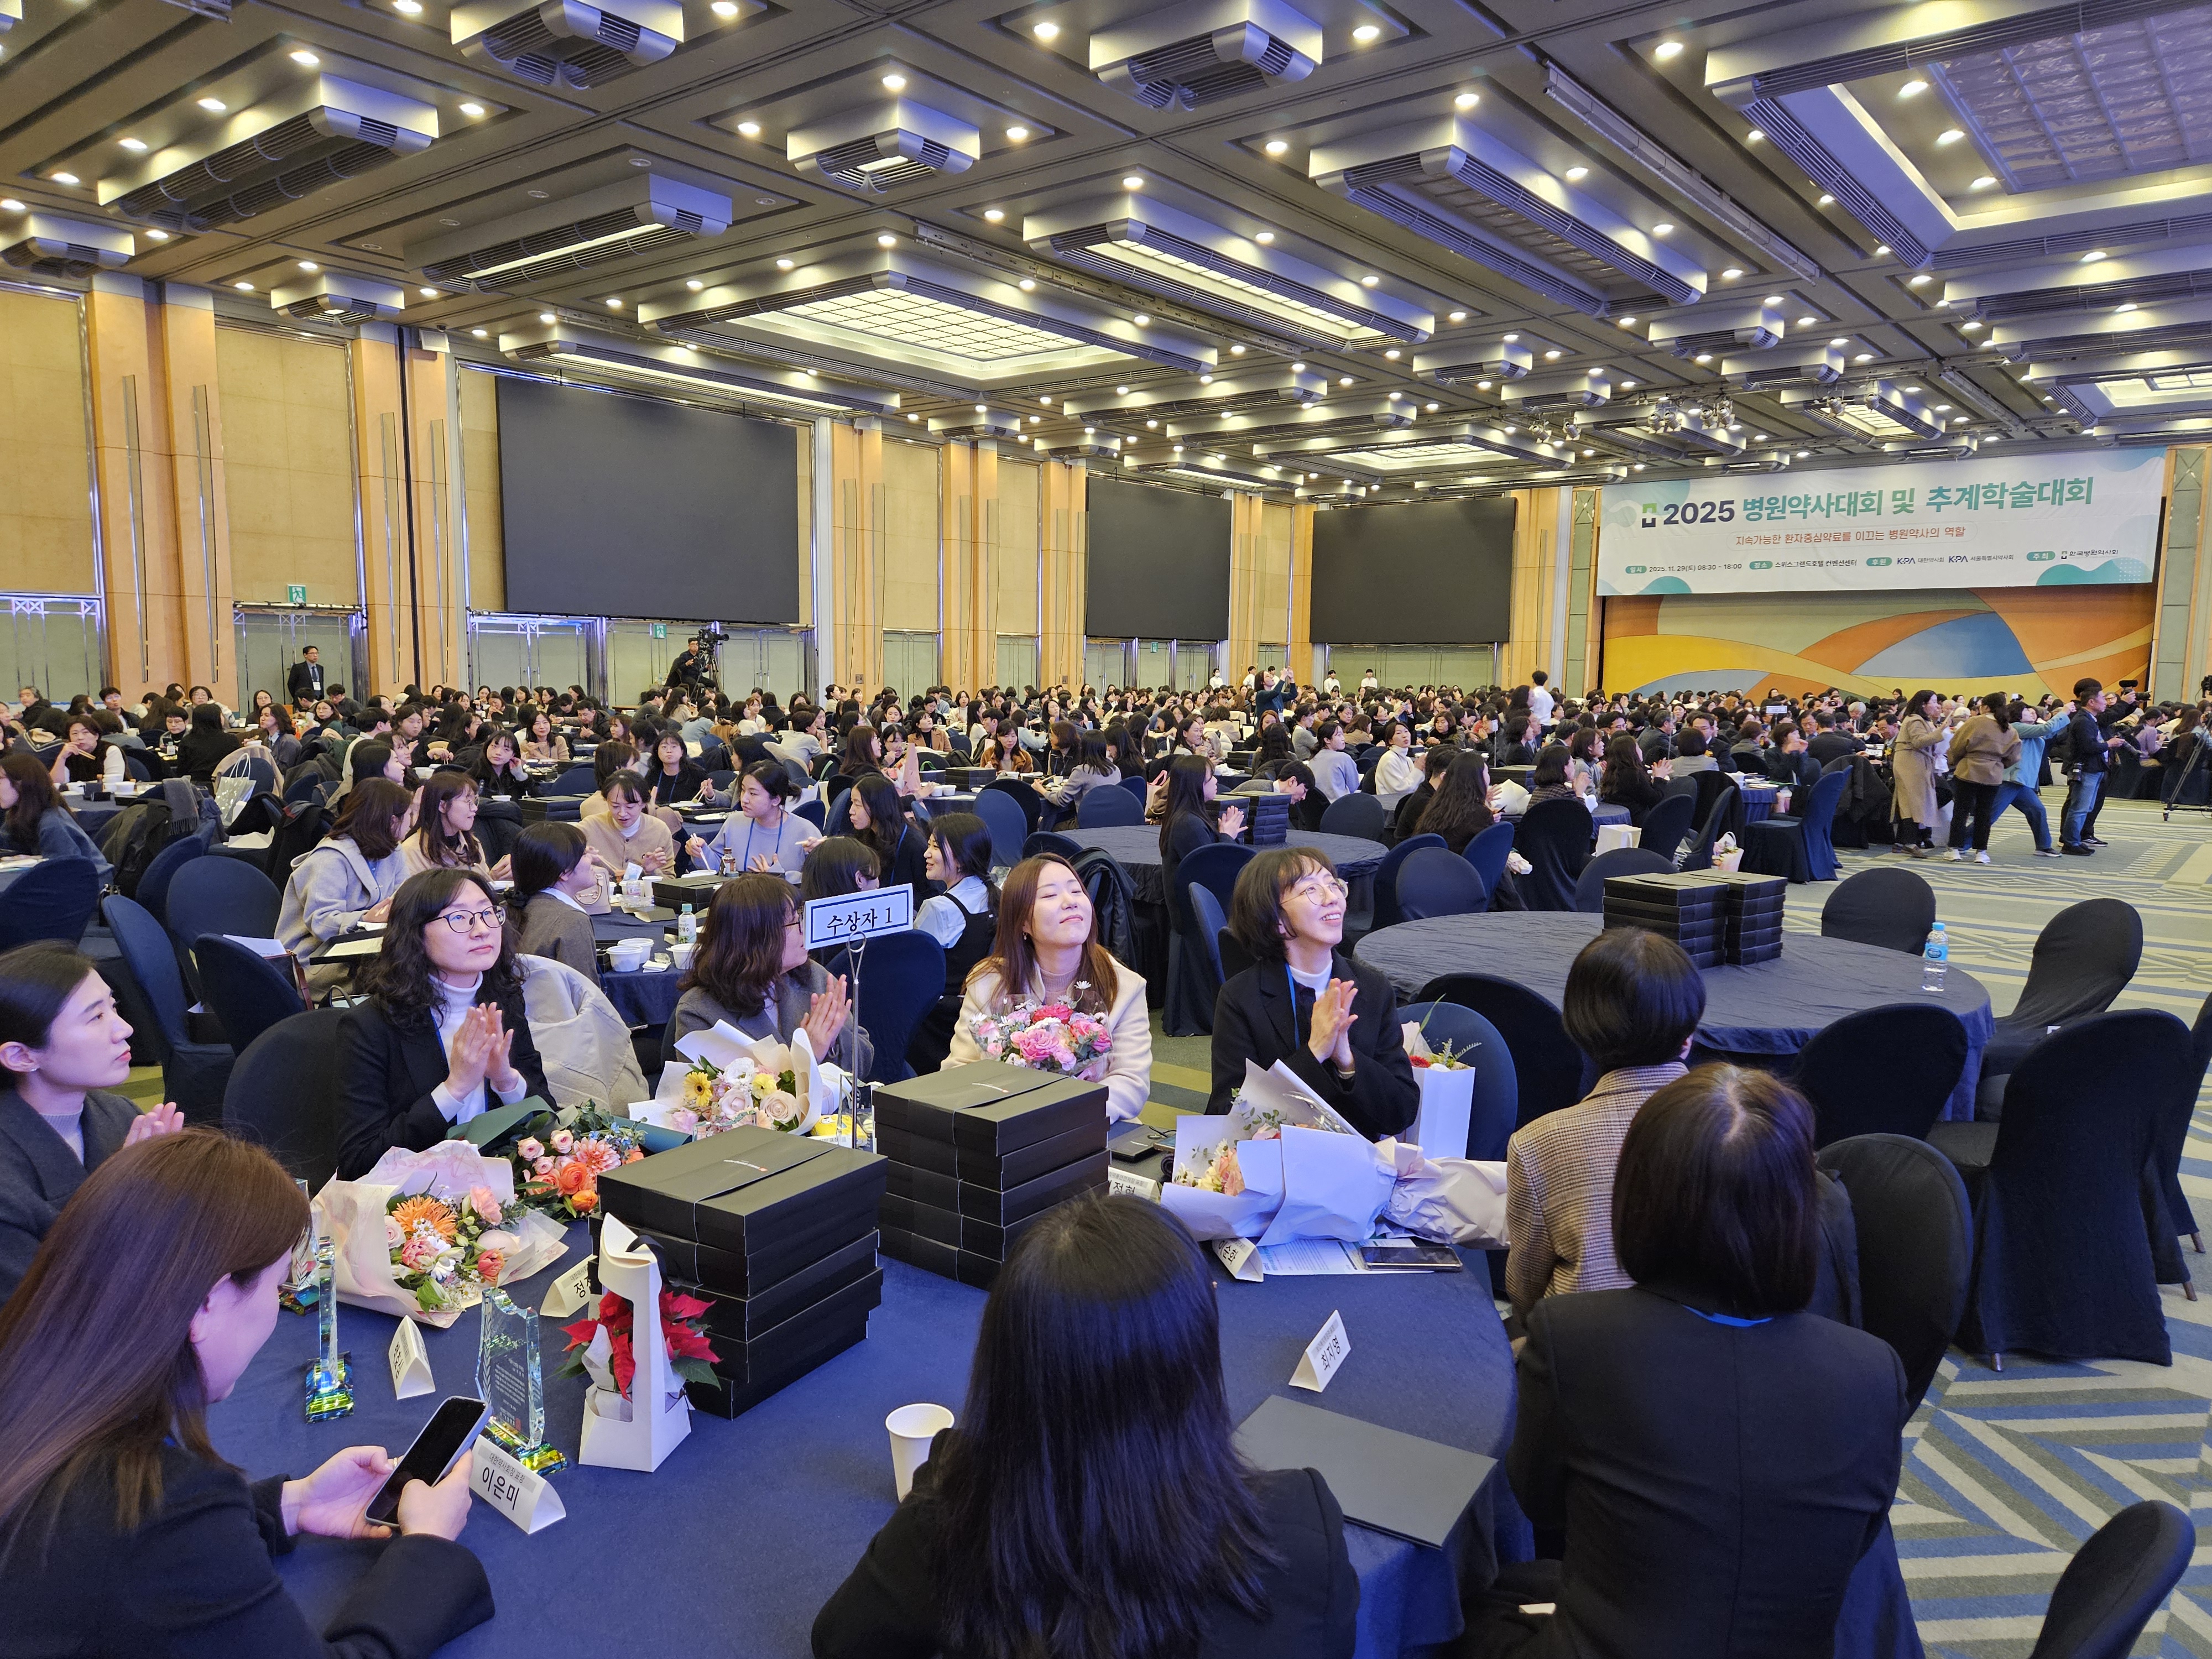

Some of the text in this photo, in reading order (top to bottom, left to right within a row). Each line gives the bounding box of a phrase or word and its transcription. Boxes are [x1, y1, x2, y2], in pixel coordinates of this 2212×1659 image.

[1663, 477, 2094, 525] 2025 병원약사대회 및 추계학술대회
[1736, 526, 1966, 545] 지속가능한 환자중심약료를 이끄는 병원약사의 역할
[827, 907, 893, 936] 수상자 1
[1219, 1240, 1238, 1265] 이순화
[1321, 1334, 1340, 1370] 최지영
[489, 1453, 525, 1483] 대한약사회장 표창
[482, 1467, 520, 1510] 이은미
